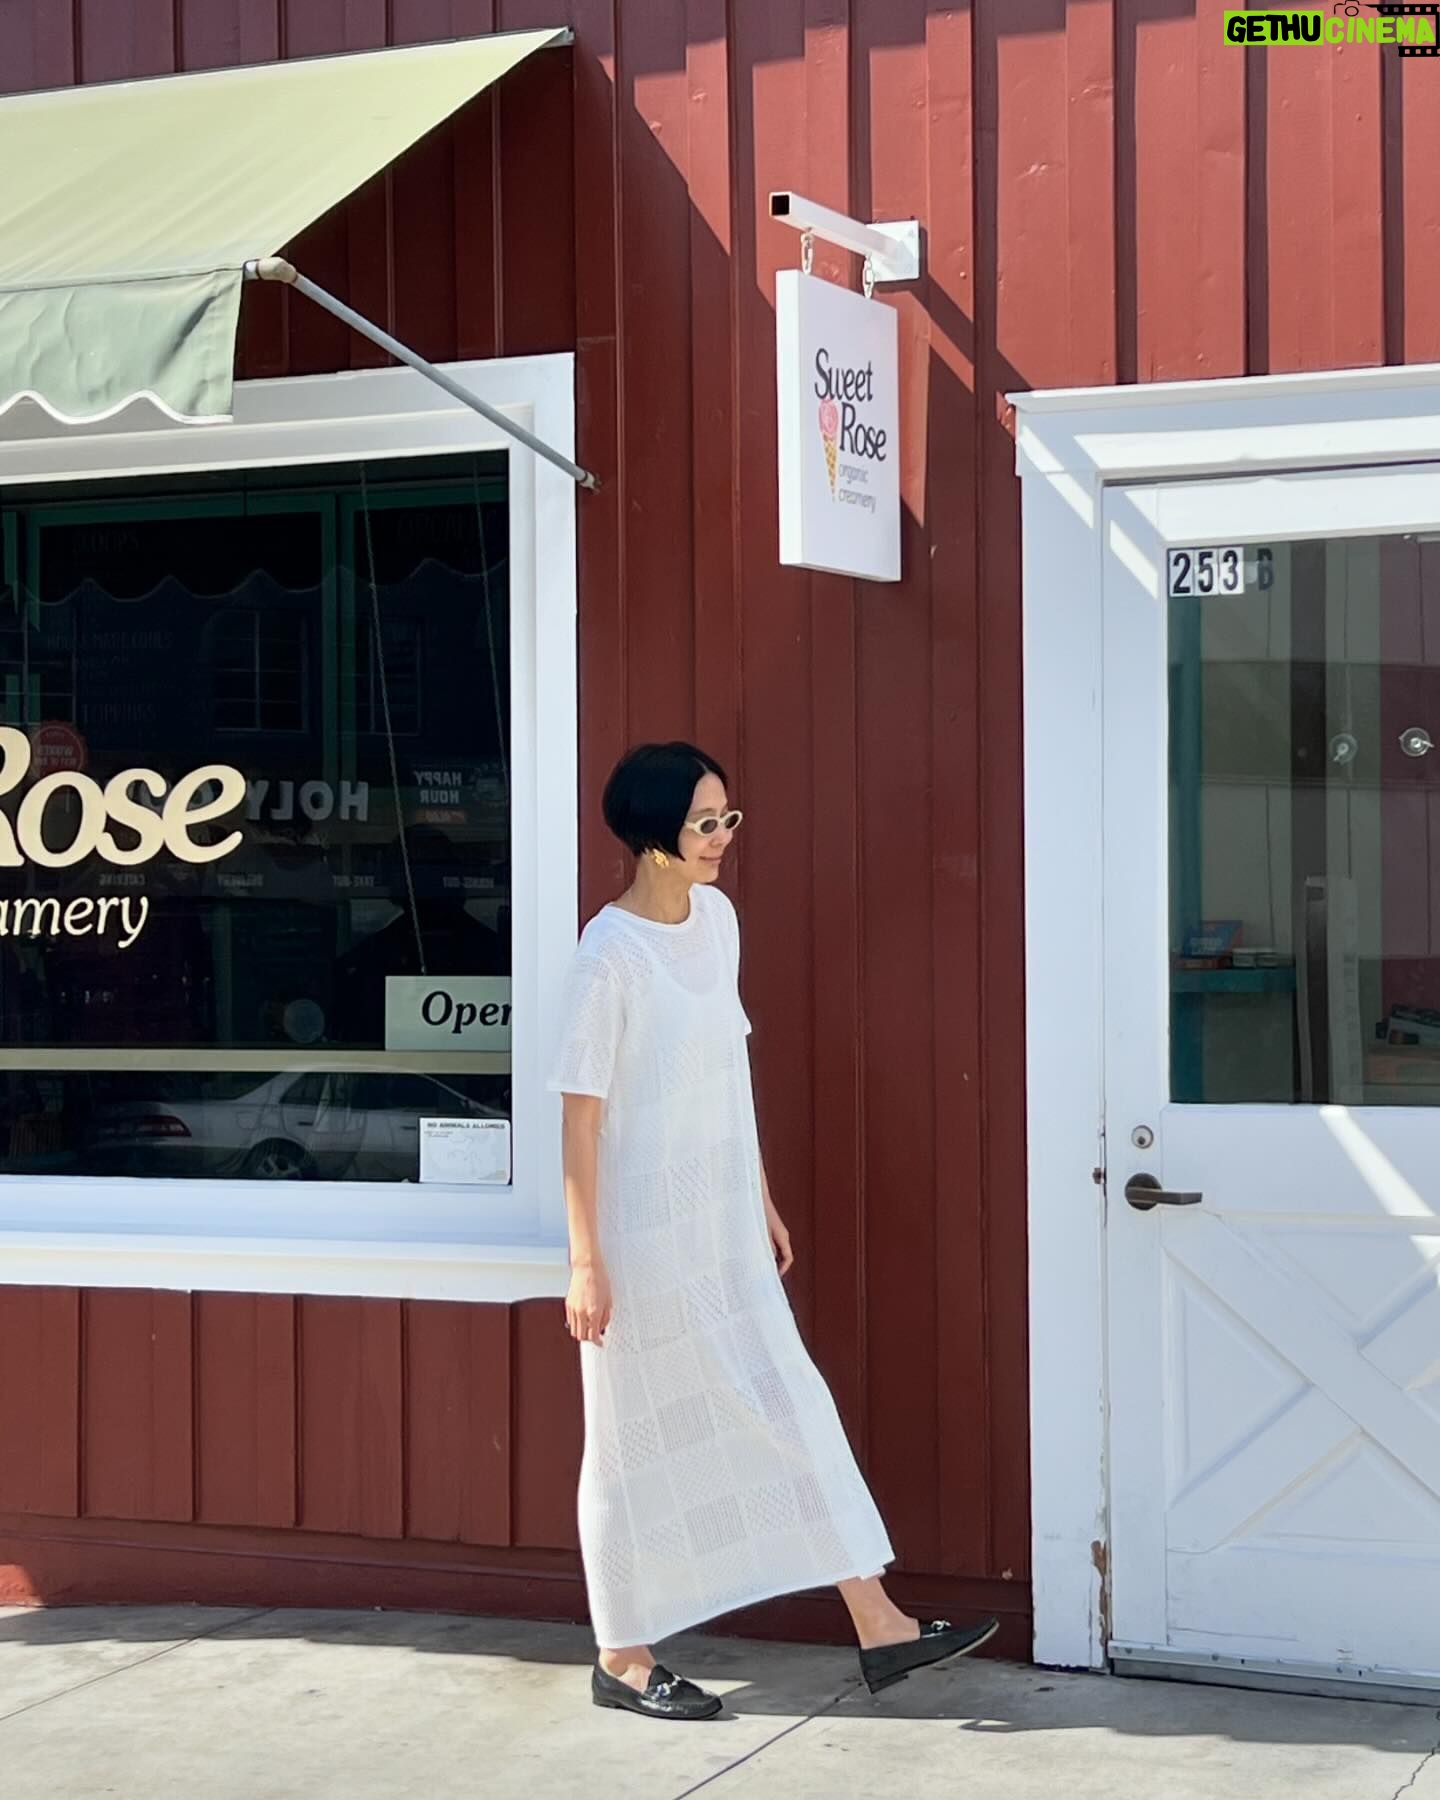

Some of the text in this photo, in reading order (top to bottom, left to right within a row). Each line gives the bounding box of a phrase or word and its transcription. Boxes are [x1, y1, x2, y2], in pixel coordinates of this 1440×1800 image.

[814, 347, 873, 402] Sweet
[840, 401, 887, 462] Rose
[838, 463, 869, 484] organic
[838, 487, 877, 514] creamery
[1172, 549, 1239, 594] 253
[0, 896, 149, 949] mery
